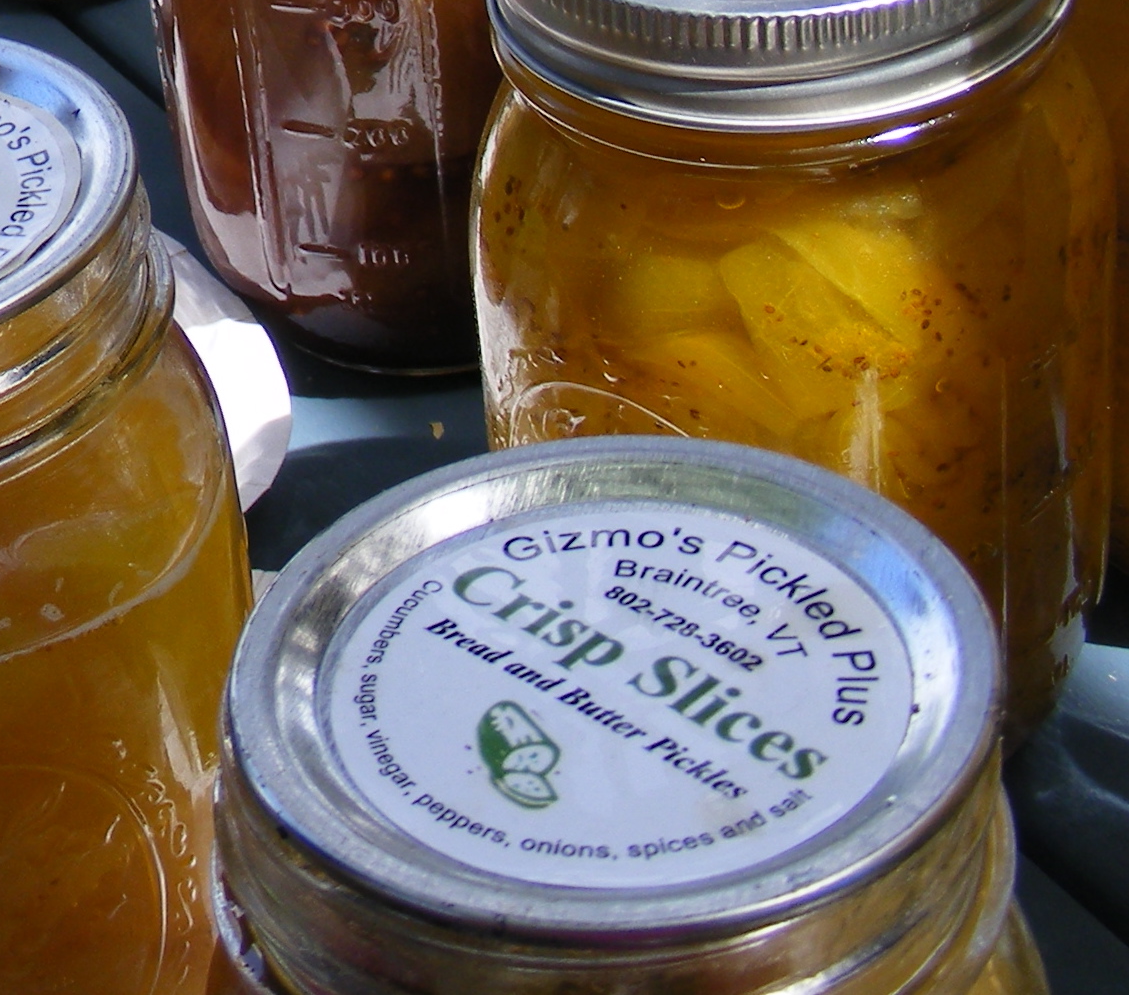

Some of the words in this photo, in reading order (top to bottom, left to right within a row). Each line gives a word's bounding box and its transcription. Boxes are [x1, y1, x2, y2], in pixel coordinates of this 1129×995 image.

[363, 579, 444, 670] Cucumbers,
[502, 526, 704, 562] Gizmo's
[716, 540, 862, 641] Pickled
[832, 647, 881, 728] Plus
[604, 585, 765, 673] 802-728-3602
[614, 558, 762, 627] Braintree,
[764, 622, 809, 662] VT
[353, 671, 379, 727] sugar,
[452, 565, 625, 671] Crisp
[628, 655, 829, 782] Slices
[424, 617, 513, 667] Bread
[504, 658, 559, 693] and
[557, 686, 648, 739] Butter
[641, 735, 752, 802] Pickles
[366, 728, 414, 797] vinegar,
[411, 792, 511, 849] peppers,
[719, 810, 767, 841] and
[768, 789, 813, 822] salt
[520, 837, 618, 861] onions,
[626, 832, 715, 862] spices
